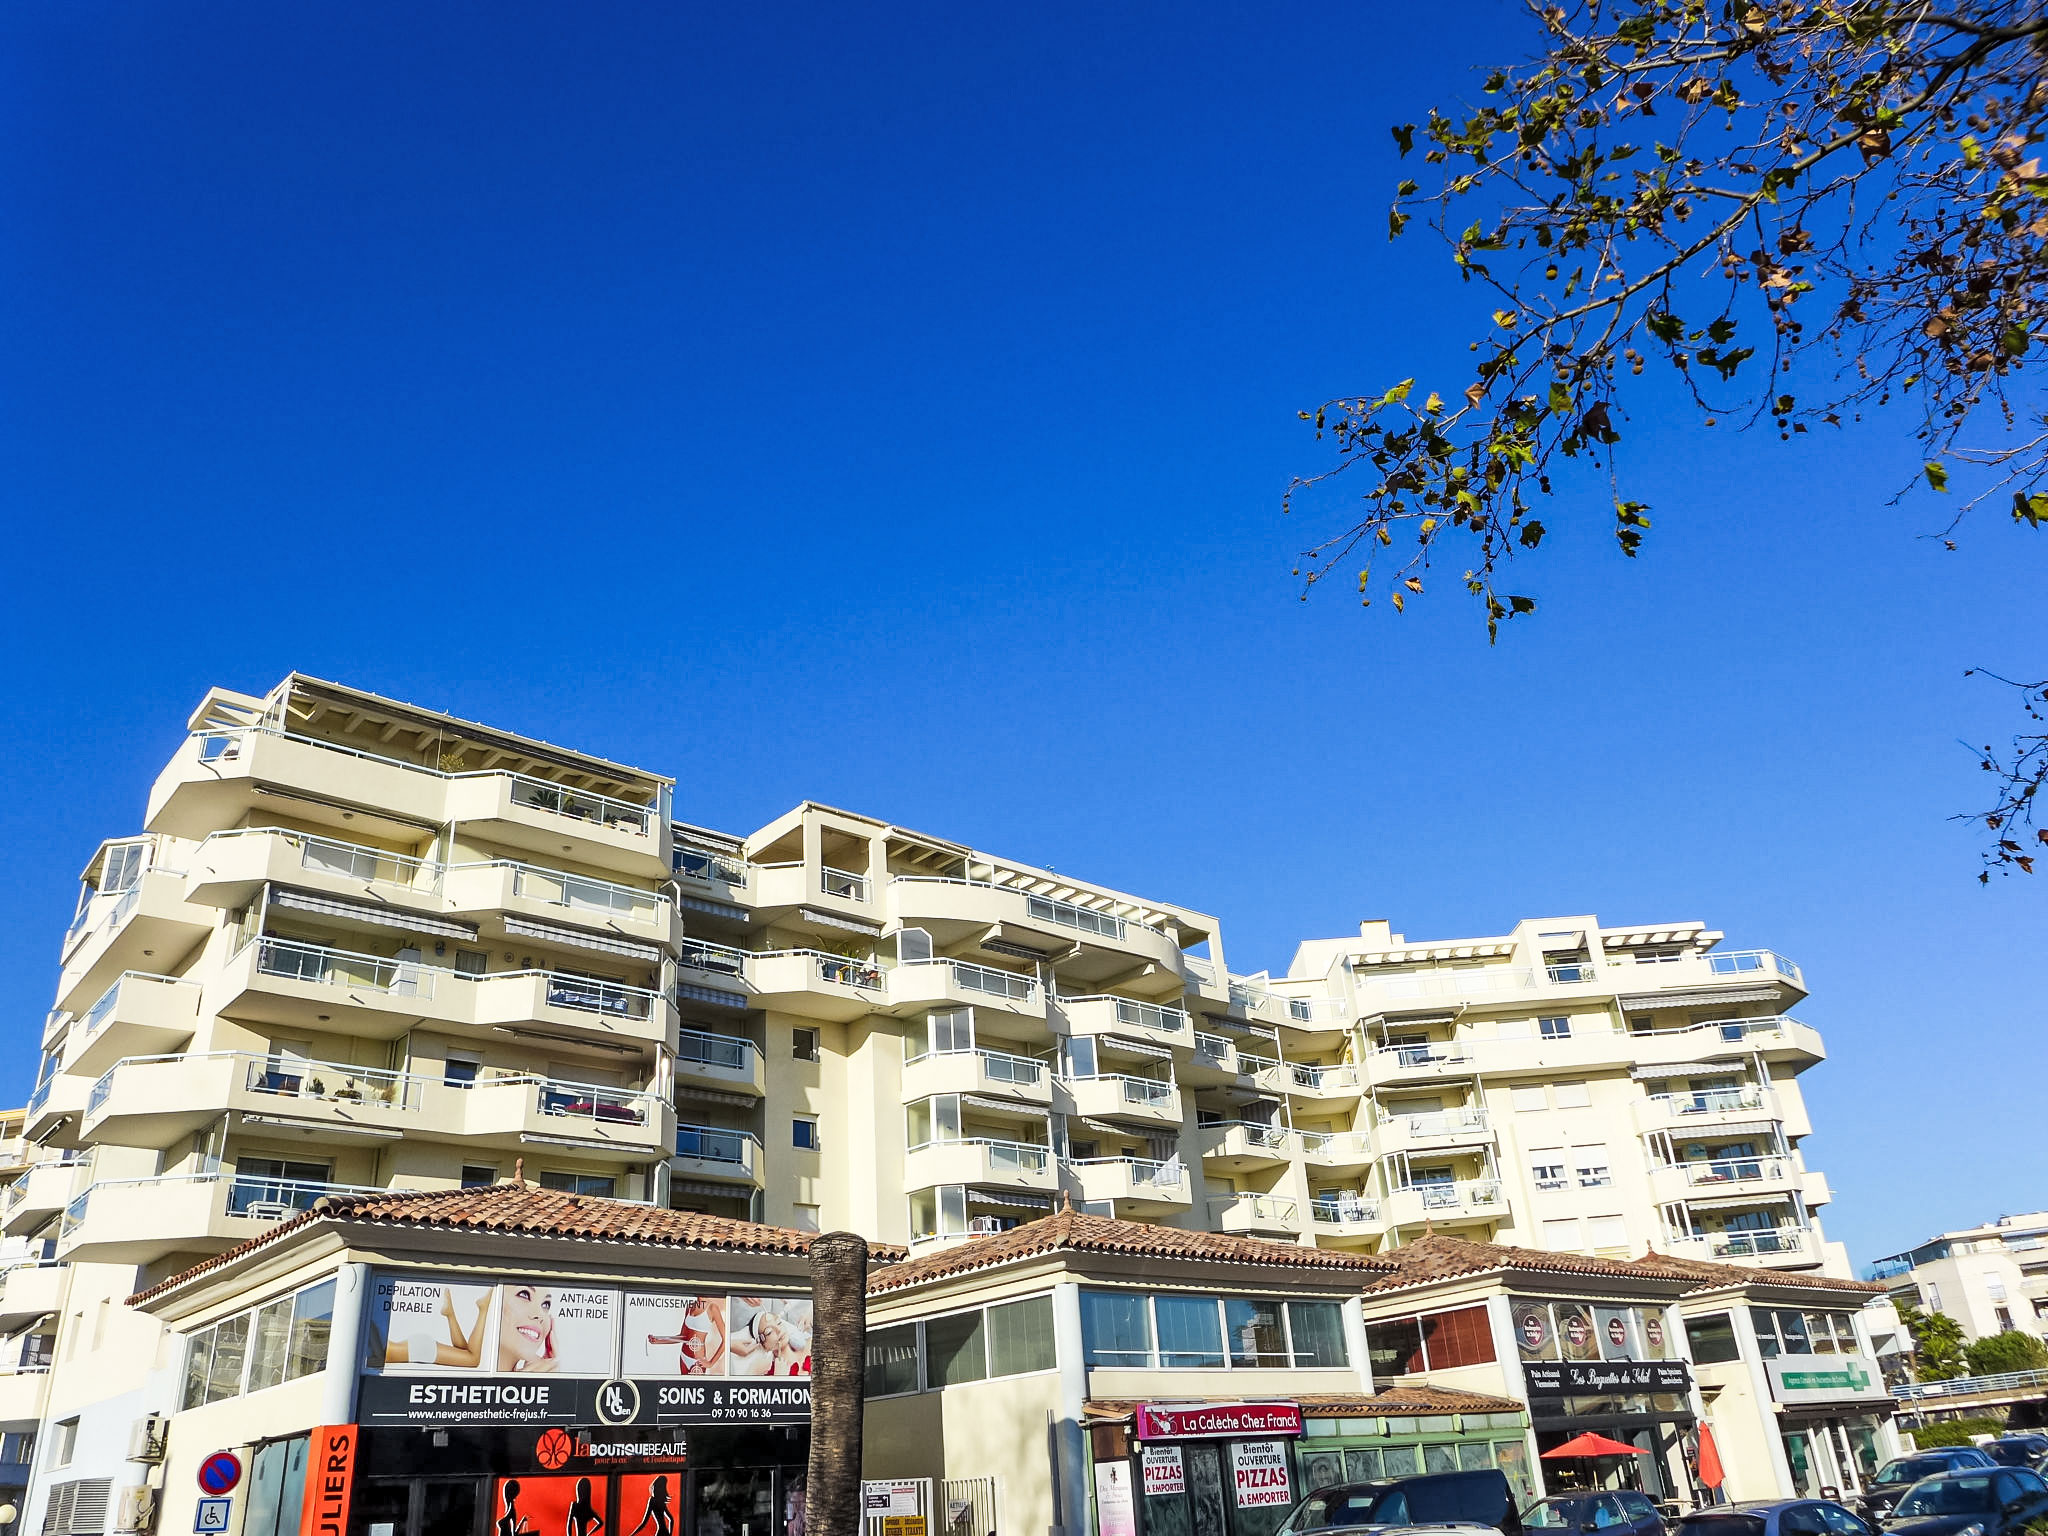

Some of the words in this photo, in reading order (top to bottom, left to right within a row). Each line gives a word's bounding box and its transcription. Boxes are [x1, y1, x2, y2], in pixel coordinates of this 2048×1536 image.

[378, 1284, 441, 1298] DEPILATION
[560, 1293, 609, 1305] ANTI-AGE
[629, 1297, 707, 1310] AMINCISSEMENT
[383, 1301, 433, 1313] DURABLE
[559, 1307, 584, 1318] ANTI
[585, 1308, 609, 1319] RIDE
[409, 1384, 550, 1405] ESTHETIQUE
[658, 1387, 705, 1405] SOINS
[713, 1391, 723, 1405] &
[408, 1408, 548, 1421] www.newgenesthetic-frejus.fr
[711, 1408, 723, 1418] 09
[724, 1408, 735, 1418] 70
[737, 1408, 748, 1418] 90
[750, 1408, 759, 1418] 16
[760, 1408, 772, 1418] 36
[1182, 1415, 1197, 1431] La
[1199, 1412, 1239, 1430] Calèche
[1241, 1413, 1266, 1429] Chez
[1266, 1411, 1298, 1427] Franck
[1242, 1443, 1274, 1455] Bientôt
[1146, 1455, 1179, 1465] OUVERTURE
[1237, 1454, 1282, 1466] OUVERTURE
[1144, 1465, 1182, 1481] PIZZAS
[1236, 1466, 1287, 1489] PIZZAS
[1146, 1485, 1151, 1493] A
[1152, 1482, 1184, 1493] EMPORTER
[1238, 1495, 1245, 1505] A
[1246, 1491, 1290, 1505] EMPORTER
